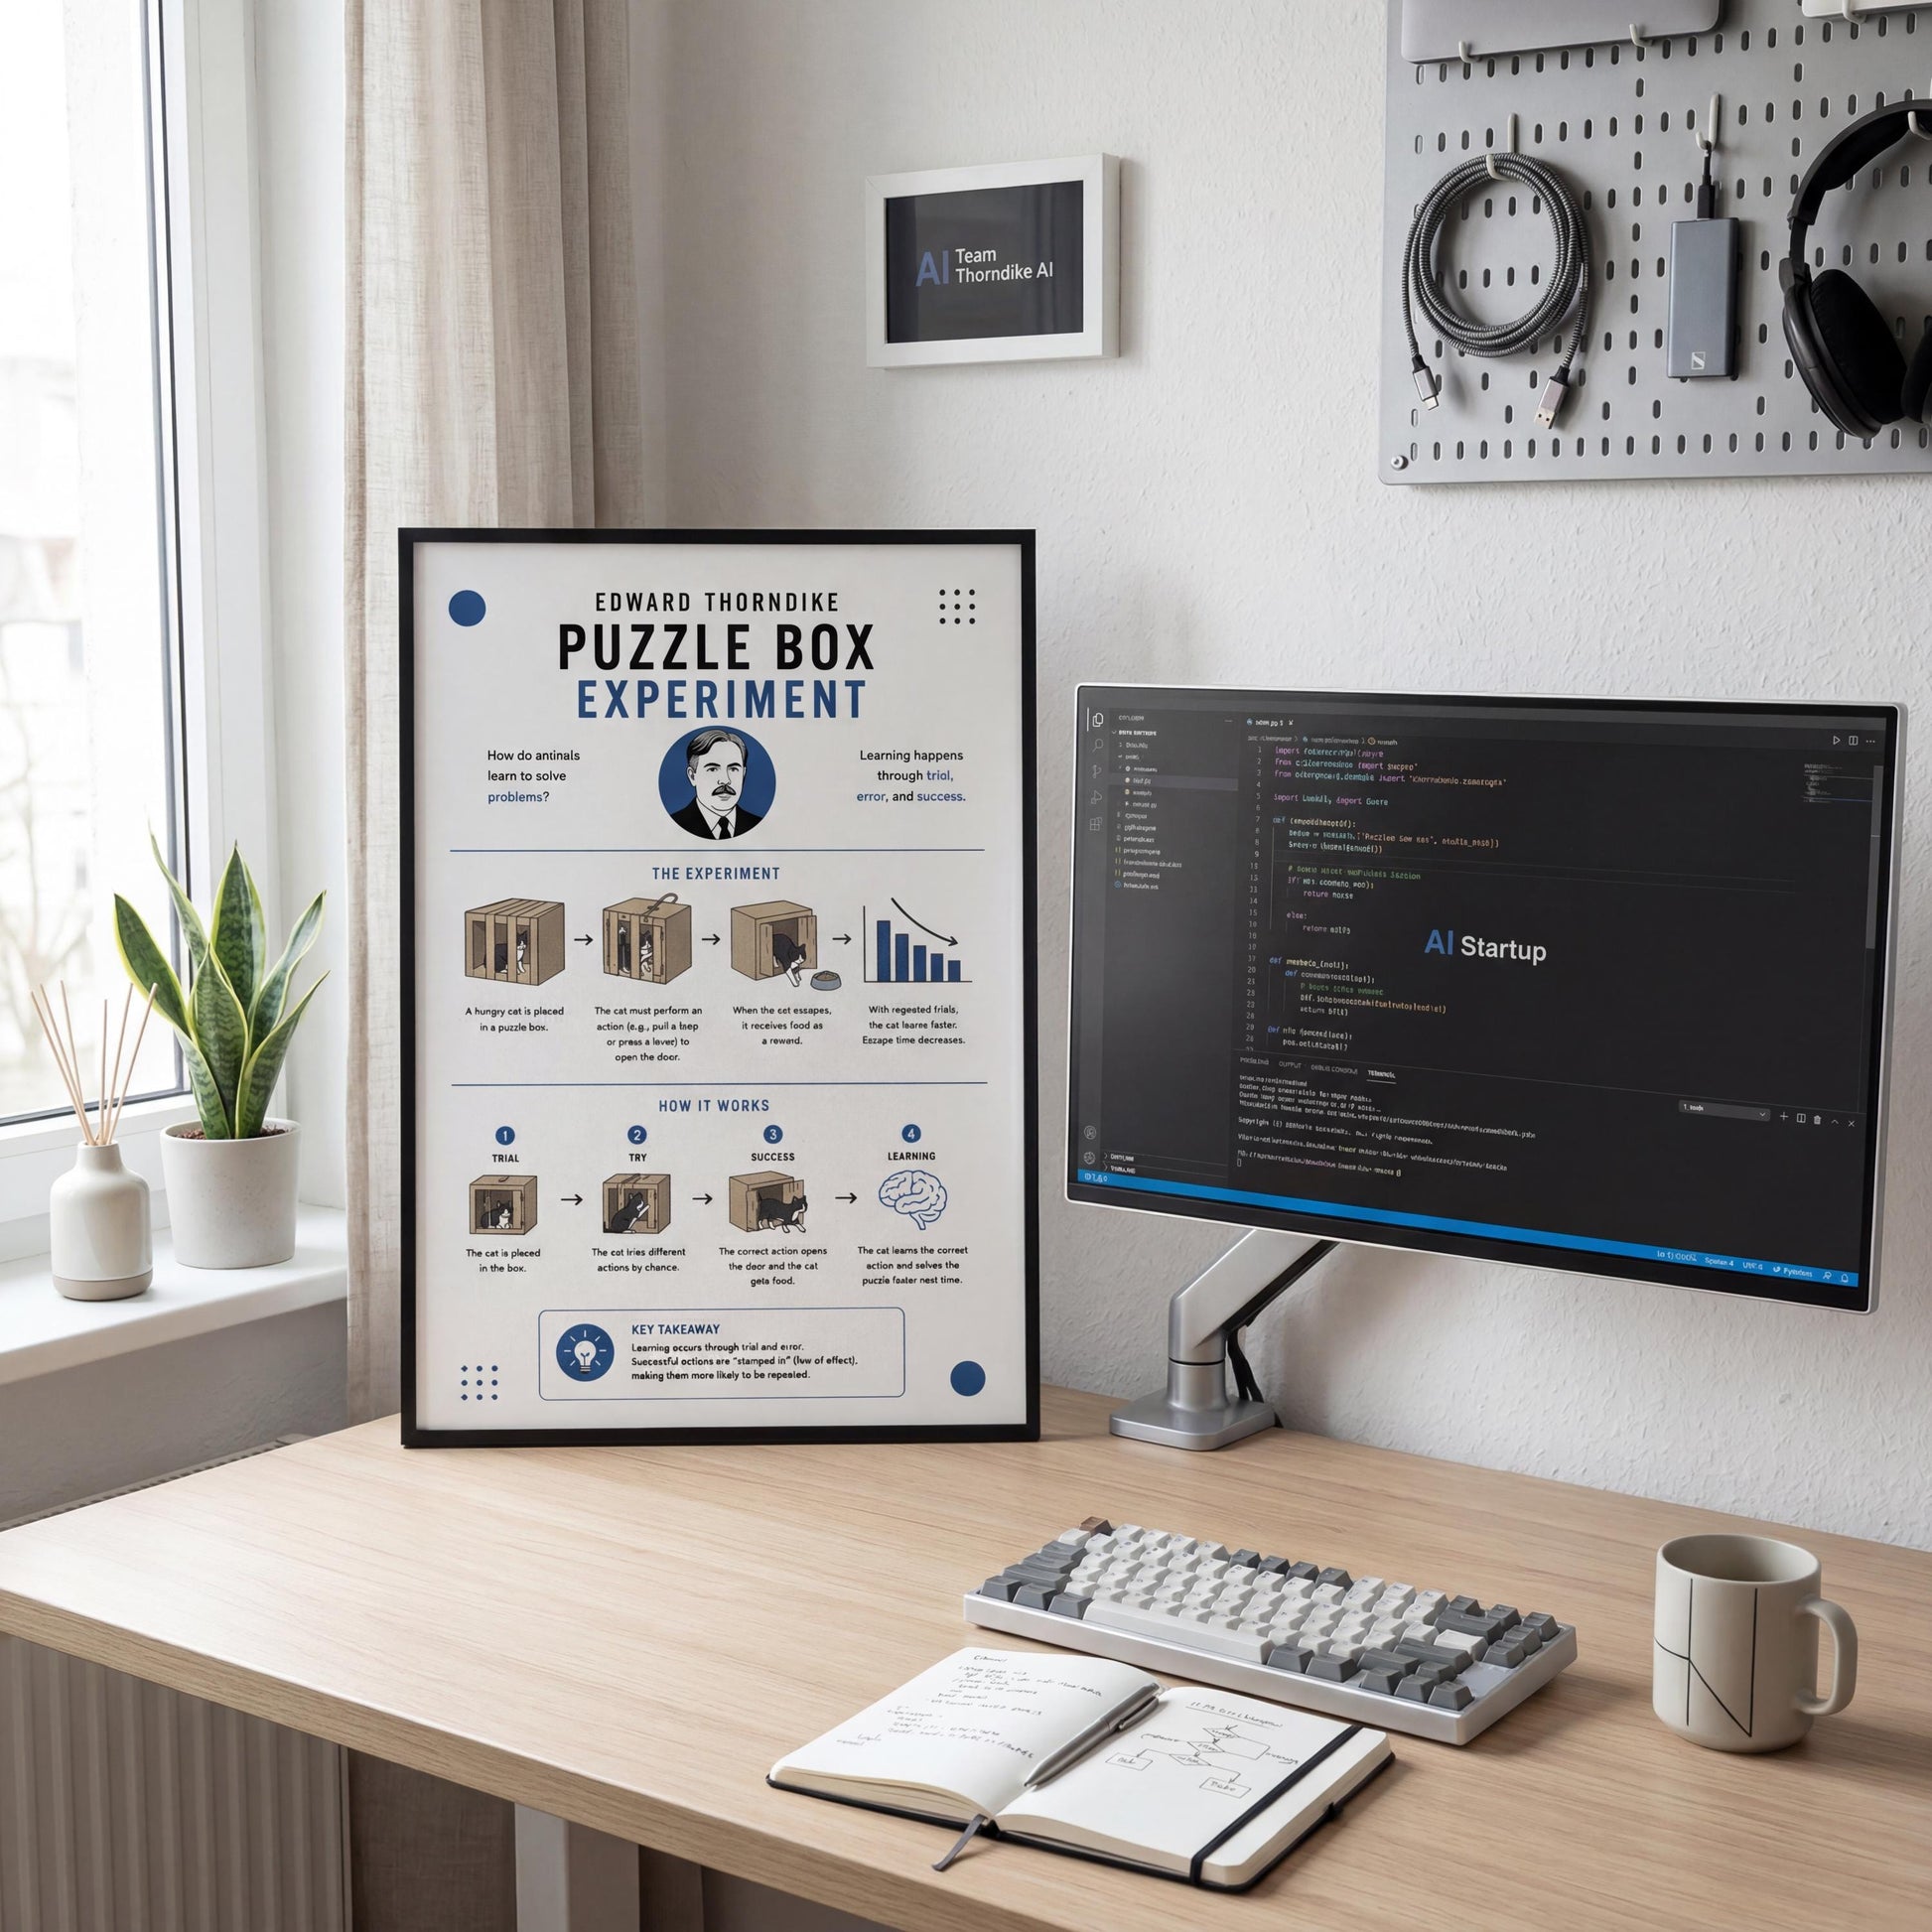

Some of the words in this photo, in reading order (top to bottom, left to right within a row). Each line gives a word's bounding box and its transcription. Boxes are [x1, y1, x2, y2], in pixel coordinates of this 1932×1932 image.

[955, 247, 997, 264] Team
[914, 250, 950, 287] AI
[955, 263, 1033, 284] Thorndike
[1036, 261, 1053, 279] AI
[596, 593, 690, 612] EDWARD
[704, 592, 838, 612] THORNDIKE
[559, 623, 750, 670] PUZZLE
[776, 623, 874, 671] BOX
[578, 680, 866, 719] EXPERIMENT
[487, 750, 514, 760] How
[517, 750, 532, 760] do
[860, 750, 910, 763] Learning
[914, 750, 964, 762] happens
[487, 770, 517, 781] learn
[520, 771, 532, 781] to
[536, 770, 567, 781] solve
[877, 769, 923, 783] through
[488, 791, 550, 804] problems?
[856, 792, 890, 803] error,
[893, 790, 913, 801] and
[916, 792, 967, 802] success.
[652, 867, 679, 880] THE
[686, 867, 780, 880] EXPERIMENT
[1424, 929, 1453, 955] AI
[1459, 935, 1547, 966] Startup
[465, 1007, 473, 1016] A
[475, 1007, 505, 1018] hungry
[524, 1007, 531, 1016] is
[653, 1006, 689, 1017] perform
[733, 1006, 759, 1015] When
[760, 1006, 775, 1015] the
[869, 1005, 890, 1014] With
[480, 1023, 488, 1032] in
[498, 1023, 527, 1034] puzzle
[529, 1023, 548, 1032] box.
[597, 1022, 624, 1031] action
[751, 1021, 787, 1030] receives
[790, 1021, 810, 1030] food
[869, 1021, 884, 1030] the
[930, 1021, 957, 1030] faster.
[896, 1035, 915, 1044] time
[917, 1035, 965, 1044] decreases.
[615, 1054, 637, 1063] open
[639, 1052, 654, 1061] the
[659, 1099, 691, 1112] HOW
[698, 1099, 711, 1112] IT
[717, 1099, 769, 1112] WORKS
[633, 1130, 641, 1141] 2
[769, 1129, 777, 1140] 3
[907, 1128, 915, 1140] 4
[491, 1154, 519, 1163] TRIAL
[628, 1153, 647, 1162] TRY
[751, 1153, 795, 1162] SUCCESS
[888, 1152, 935, 1161] LEARNING
[466, 1249, 483, 1258] The
[592, 1248, 608, 1257] The
[648, 1247, 686, 1256] different
[719, 1247, 735, 1256] The
[800, 1248, 828, 1257] opens
[489, 1264, 504, 1273] the
[507, 1263, 526, 1272] box.
[597, 1263, 629, 1272] actions
[631, 1264, 642, 1274] by
[729, 1262, 743, 1271] the
[768, 1262, 785, 1271] and
[866, 1261, 894, 1270] action
[897, 1261, 913, 1270] and
[772, 1276, 795, 1285] food.
[631, 1324, 654, 1335] KEY
[657, 1323, 720, 1334] TAKEAWAY
[631, 1343, 670, 1354] Learning
[704, 1342, 740, 1354] through
[742, 1342, 759, 1351] trial
[760, 1342, 777, 1351] and
[814, 1355, 824, 1365] of
[666, 1371, 689, 1380] them
[717, 1370, 740, 1381] likely
[754, 1370, 765, 1379] be
